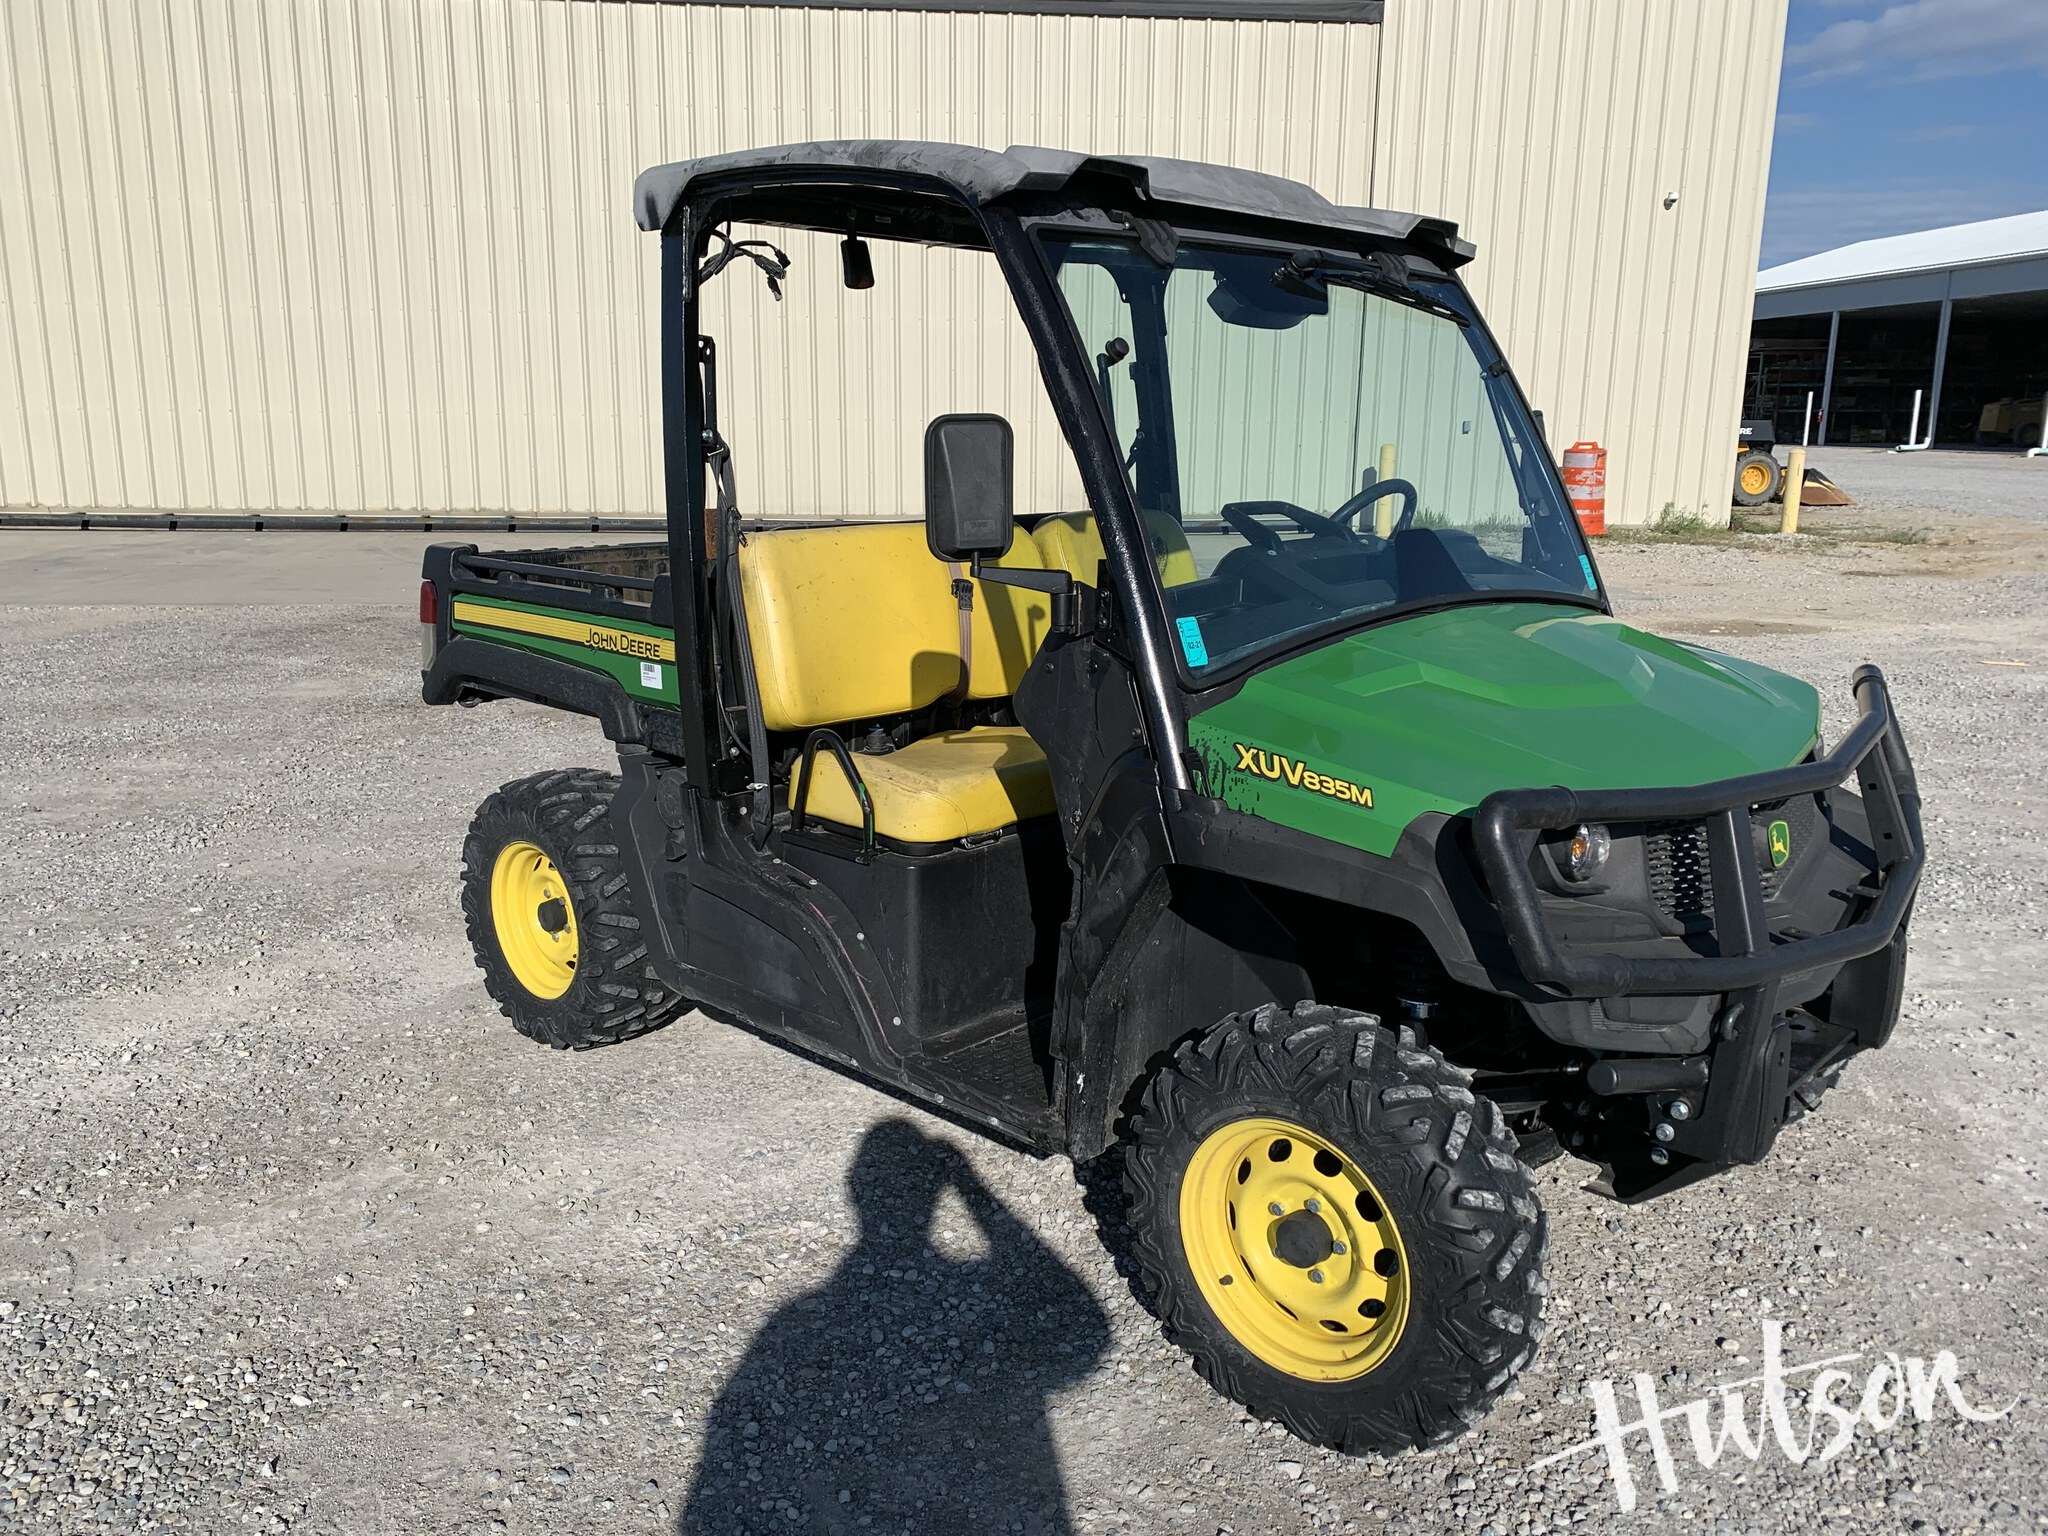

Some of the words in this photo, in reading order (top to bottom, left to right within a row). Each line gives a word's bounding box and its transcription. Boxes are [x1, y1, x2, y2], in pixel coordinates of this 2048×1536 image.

[585, 627, 618, 650] JOHN
[620, 633, 661, 658] DEERE
[1233, 742, 1374, 810] XUV835M
